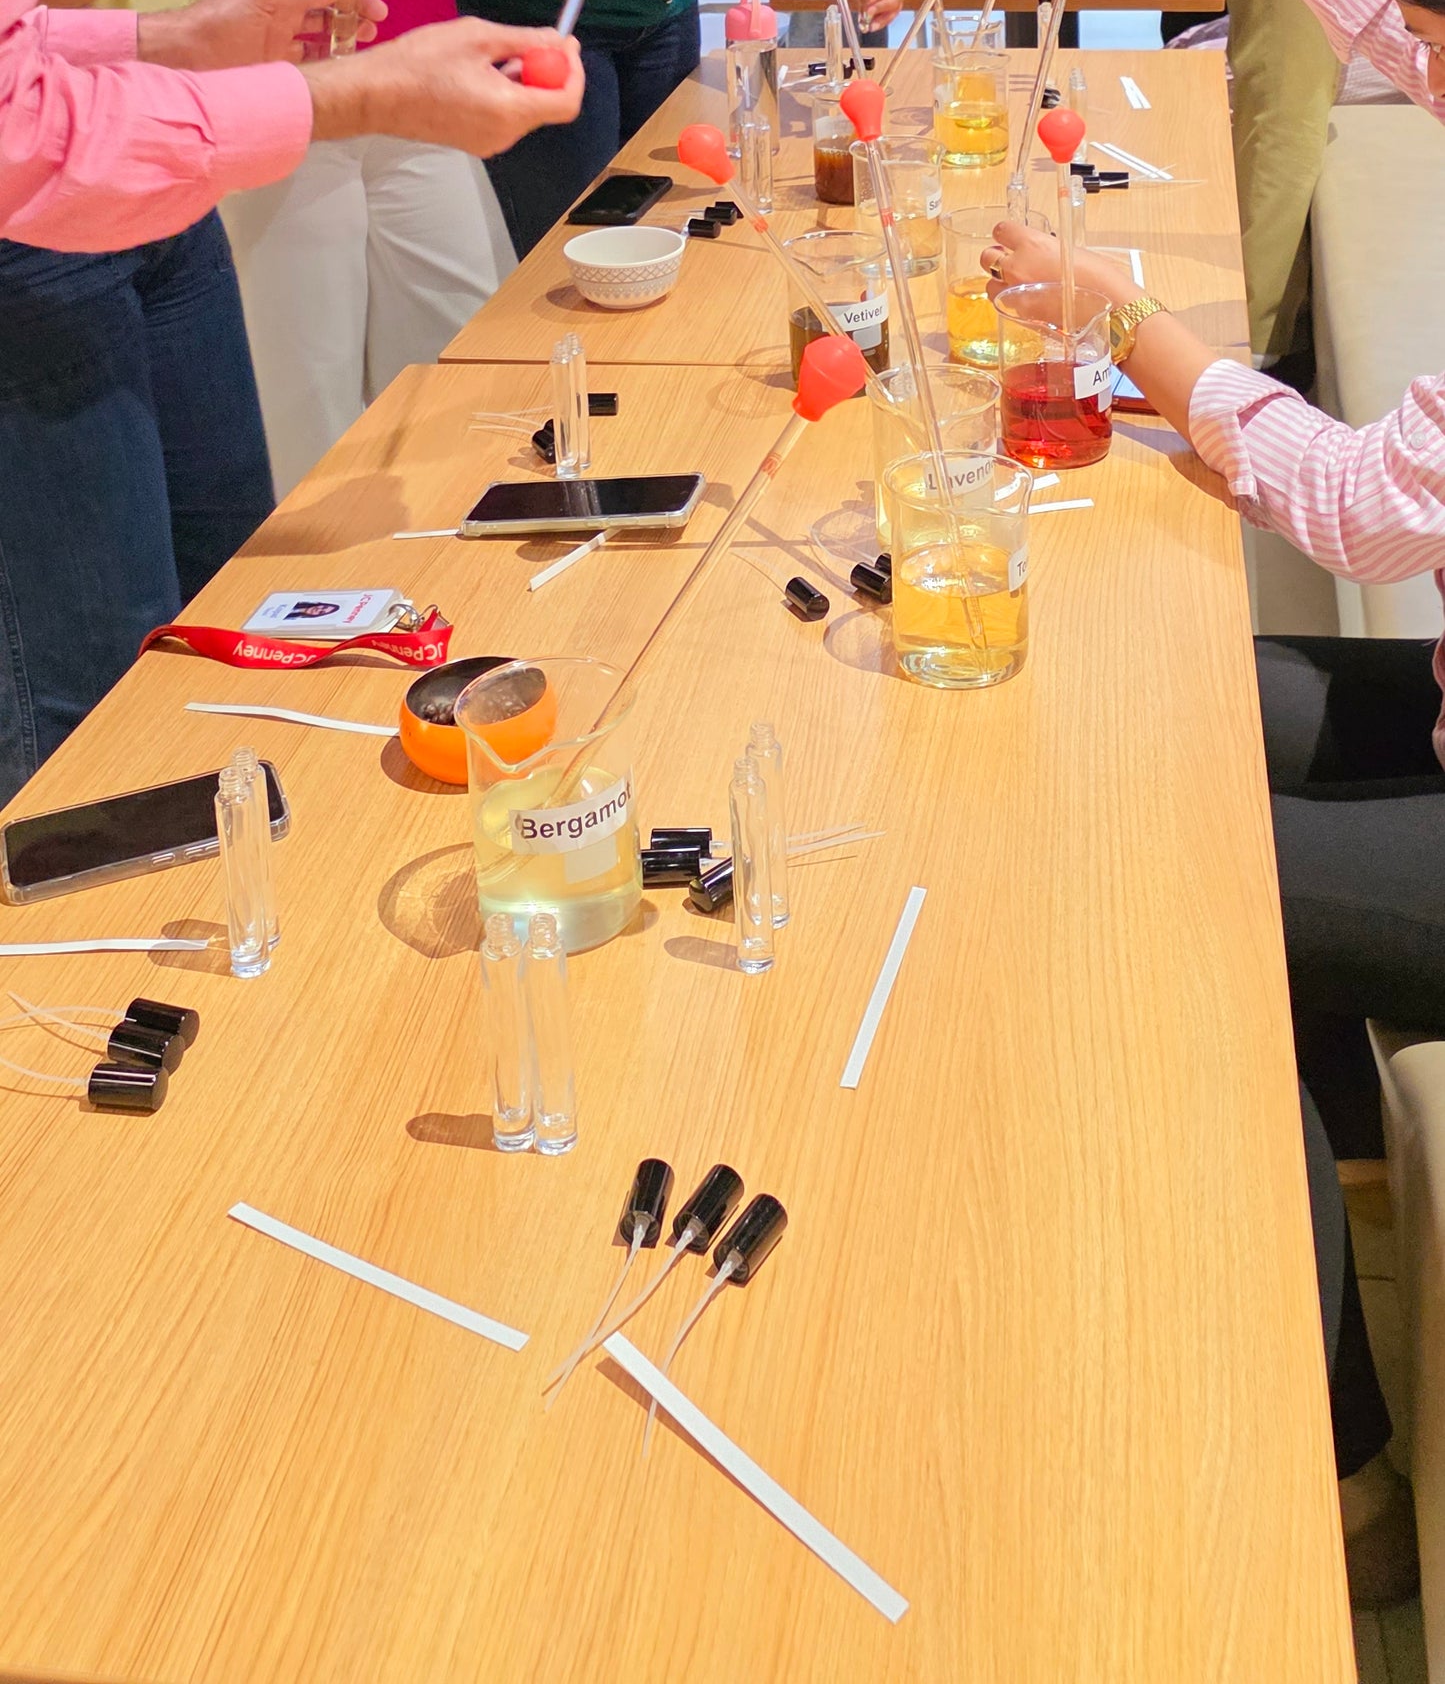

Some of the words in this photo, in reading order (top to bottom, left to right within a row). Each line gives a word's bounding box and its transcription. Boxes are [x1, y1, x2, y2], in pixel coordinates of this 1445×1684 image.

[843, 305, 883, 324] Vetiver
[232, 639, 317, 665] JCPenney
[520, 780, 632, 839] Bergamot
